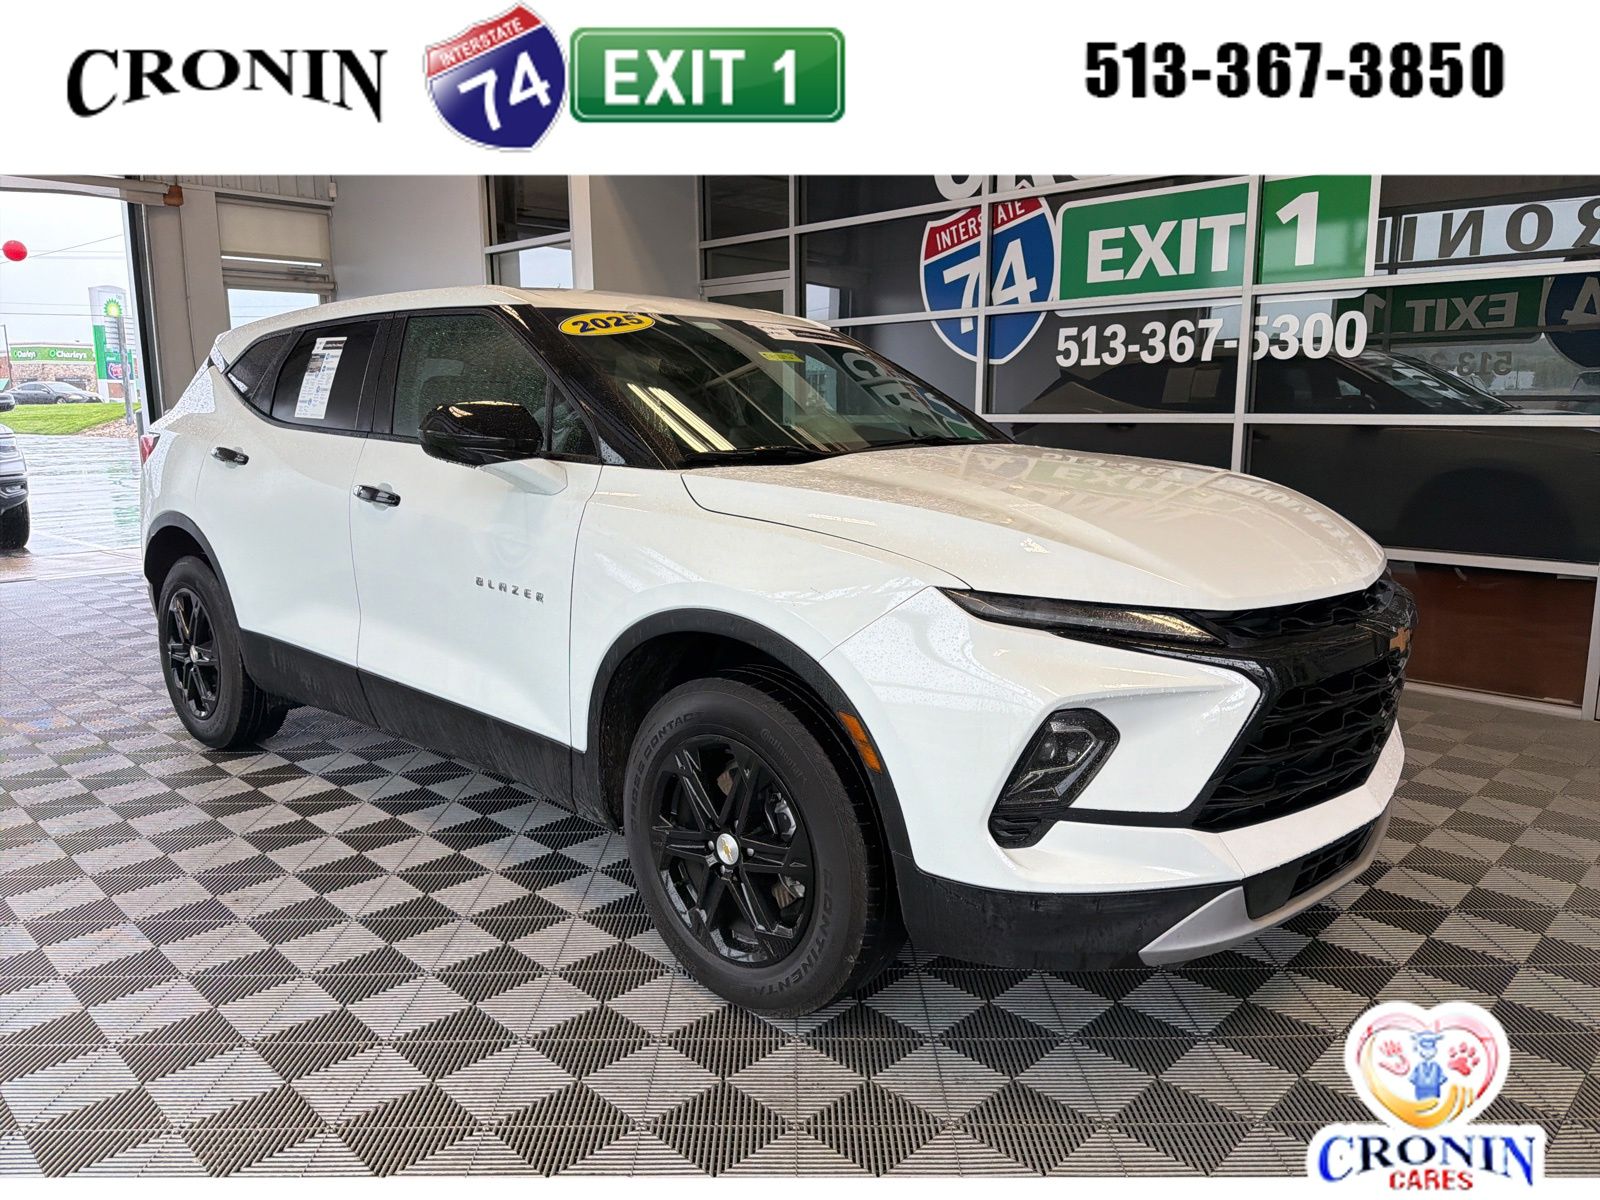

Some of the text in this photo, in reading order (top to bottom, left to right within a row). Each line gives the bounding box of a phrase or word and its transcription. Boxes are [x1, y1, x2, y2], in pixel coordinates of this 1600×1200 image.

[935, 200, 1025, 251] INTERSATE
[1087, 191, 1318, 283] EXIT 1
[942, 238, 1038, 334] 74
[572, 314, 643, 333] 2025
[56, 350, 87, 359] Charleys
[475, 576, 545, 603] BLAZER
[643, 711, 704, 760] CONTAC
[752, 868, 833, 995] CONTINENTA
